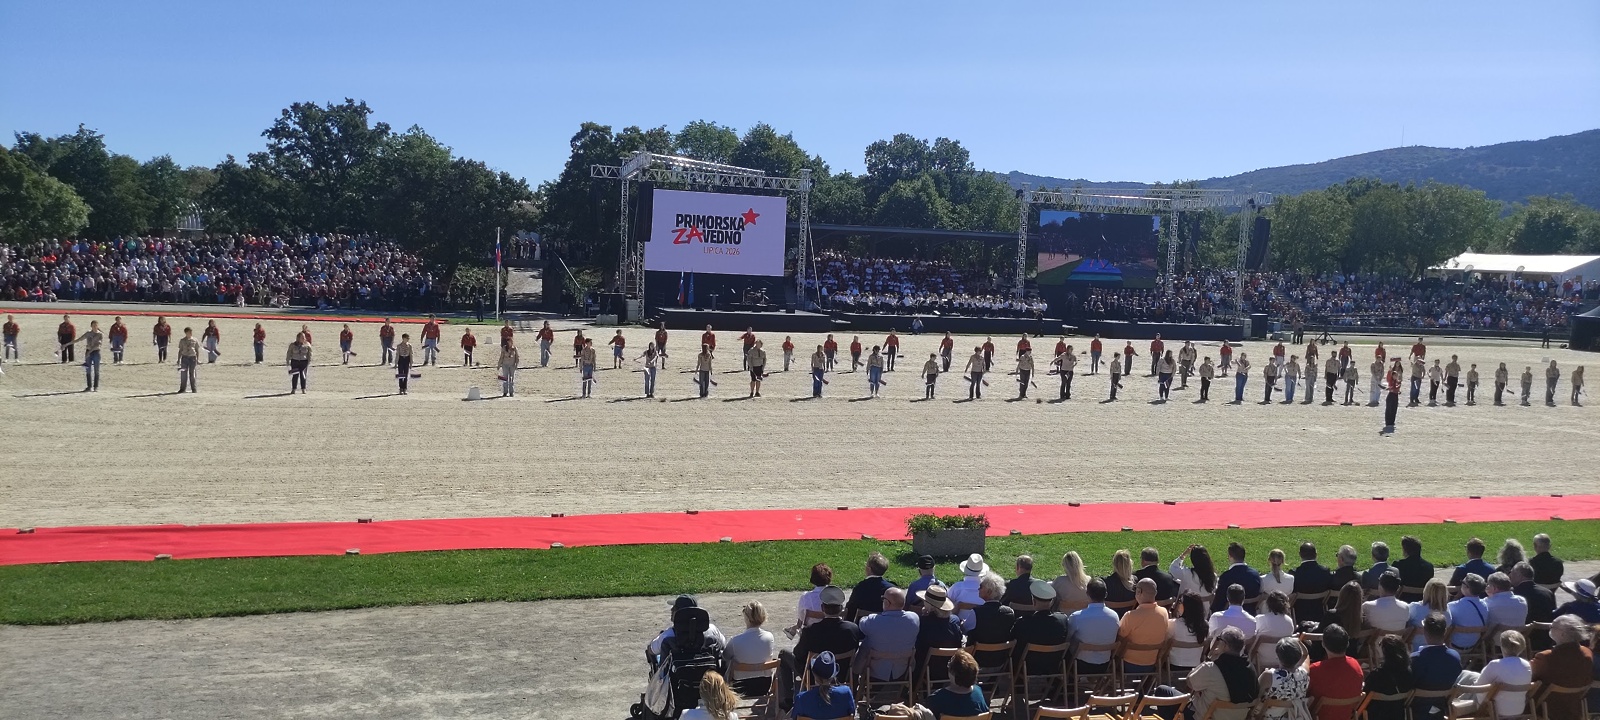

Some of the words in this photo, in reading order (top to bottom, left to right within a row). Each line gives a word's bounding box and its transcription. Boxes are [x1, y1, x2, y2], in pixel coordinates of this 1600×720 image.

[675, 213, 745, 231] PRIMORSKA
[703, 246, 723, 255] LIPICA
[725, 247, 740, 256] 2026
